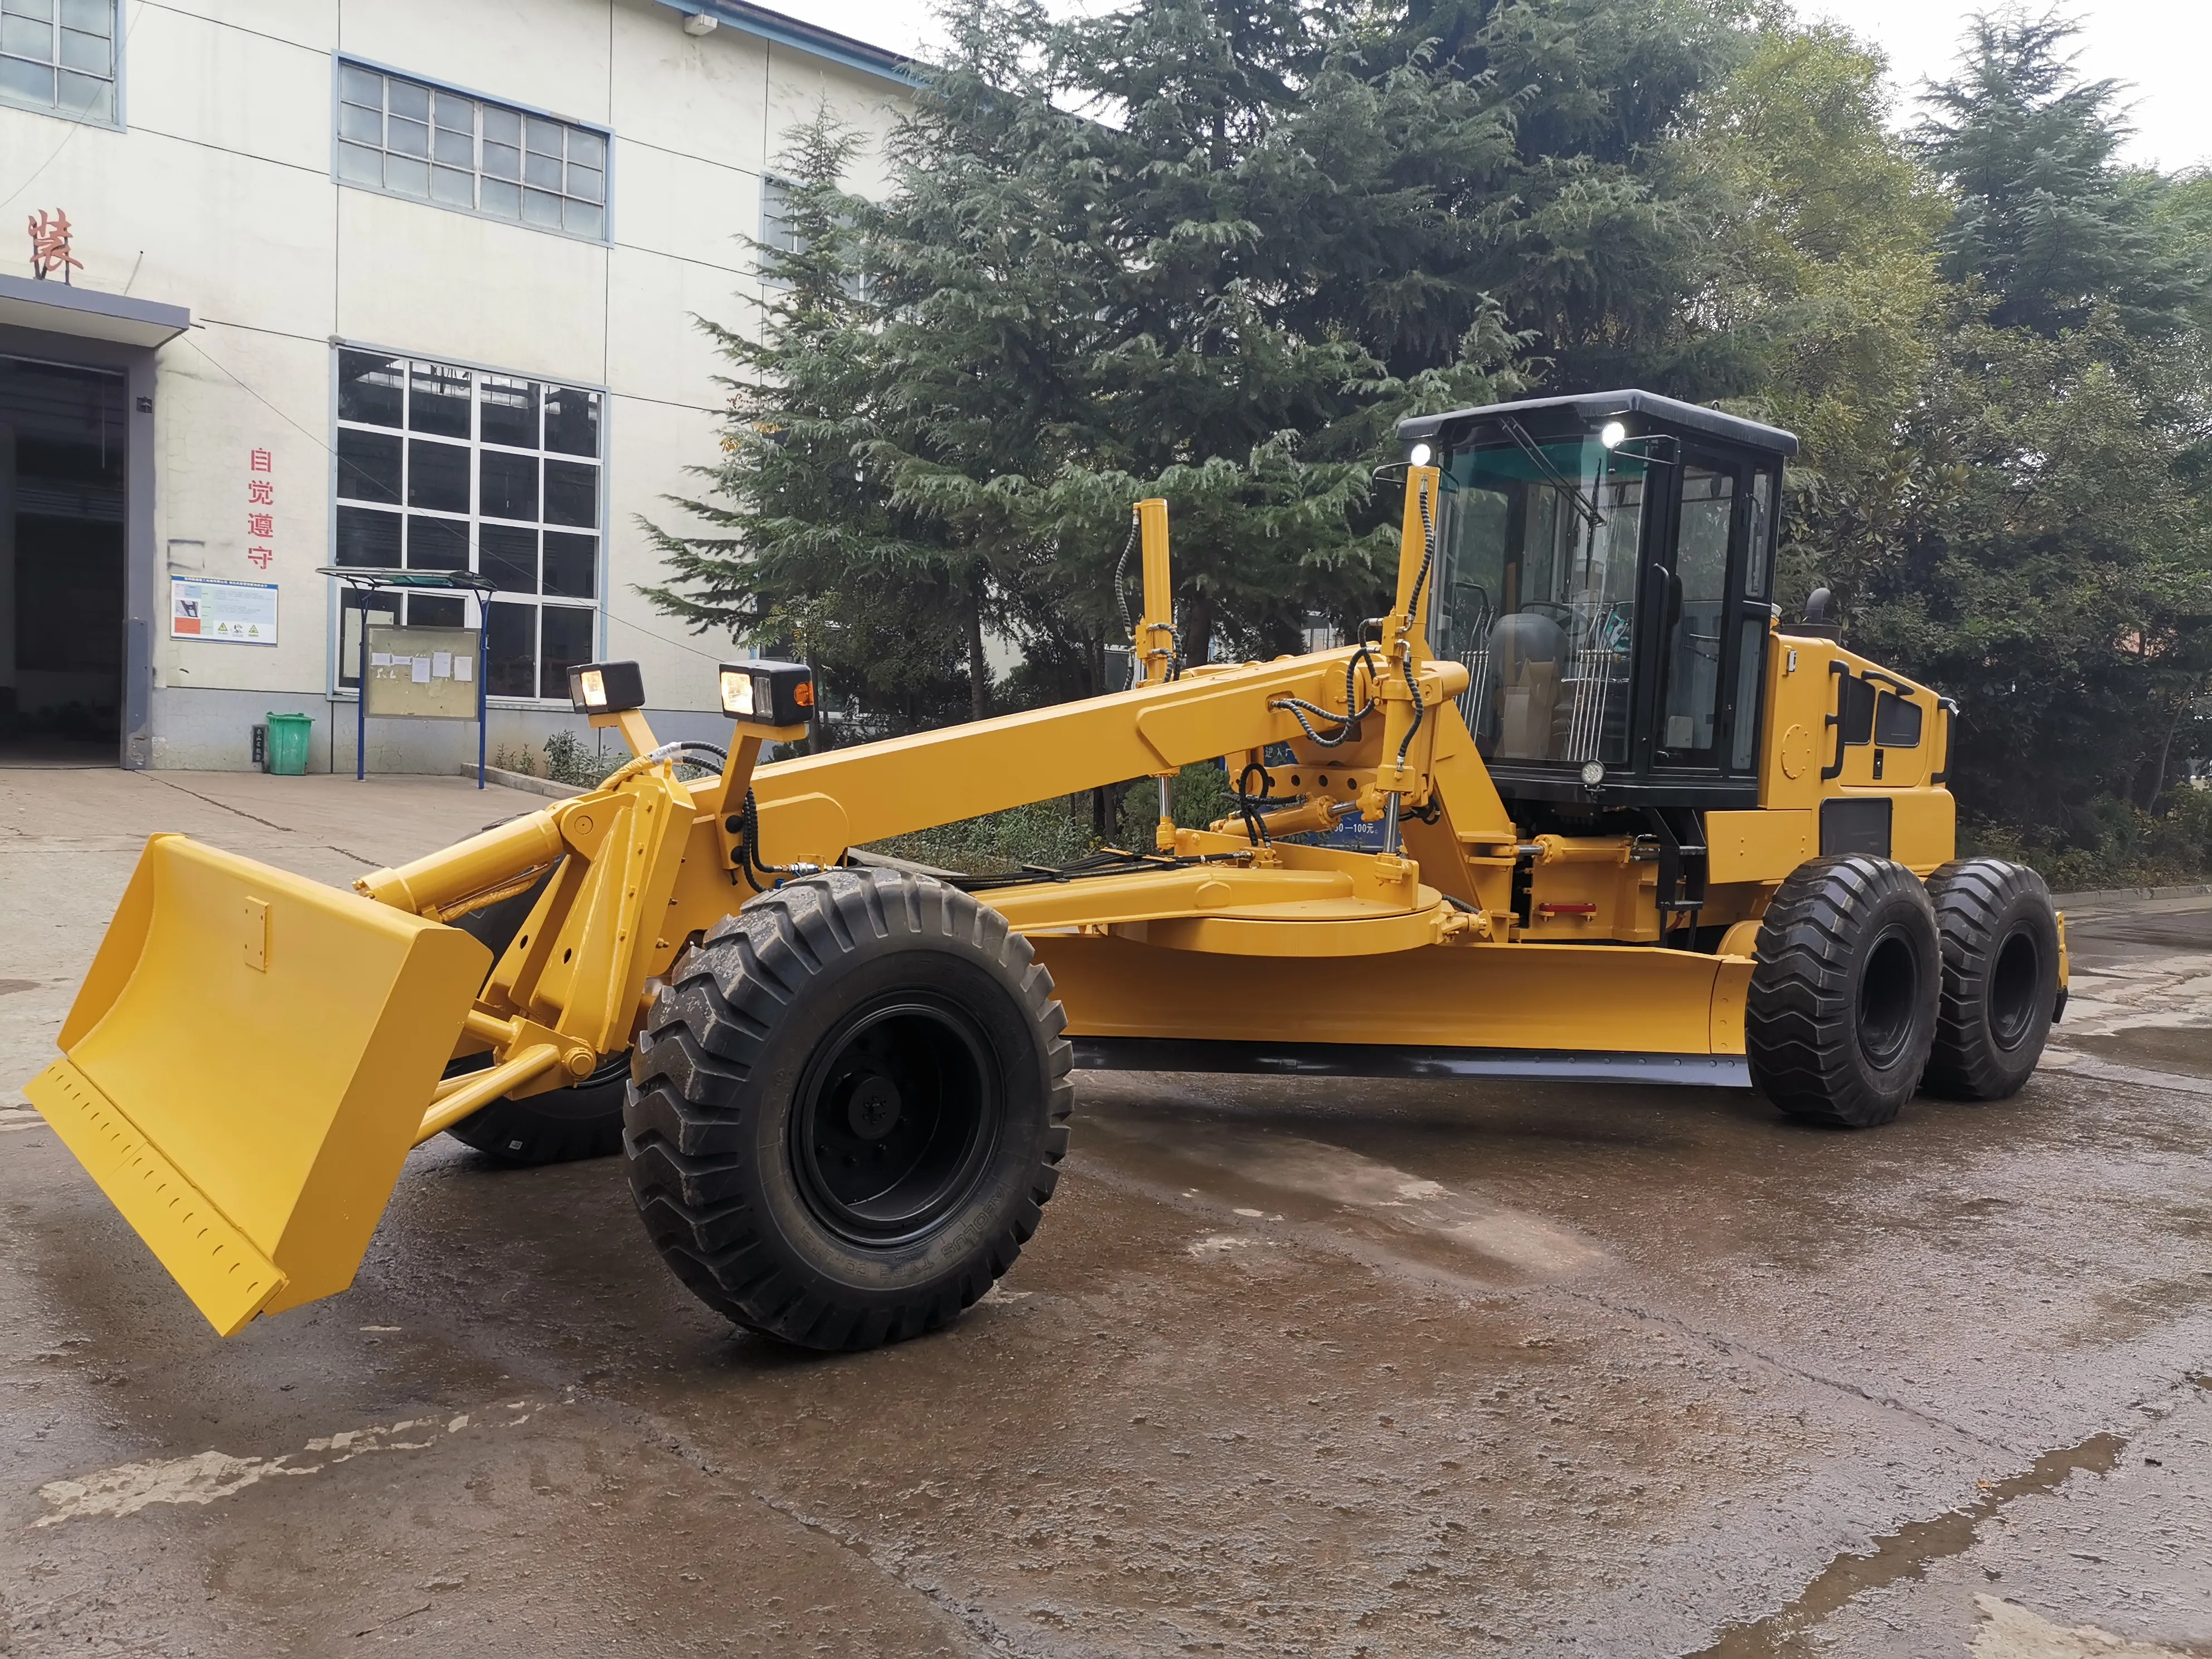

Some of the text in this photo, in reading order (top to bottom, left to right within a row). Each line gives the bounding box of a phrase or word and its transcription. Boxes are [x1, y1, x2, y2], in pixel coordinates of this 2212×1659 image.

[28, 208, 84, 270] 装
[248, 448, 274, 570] 自觉遵守
[940, 1185, 1006, 1259] AEOLUS
[879, 1257, 935, 1279] TYRE
